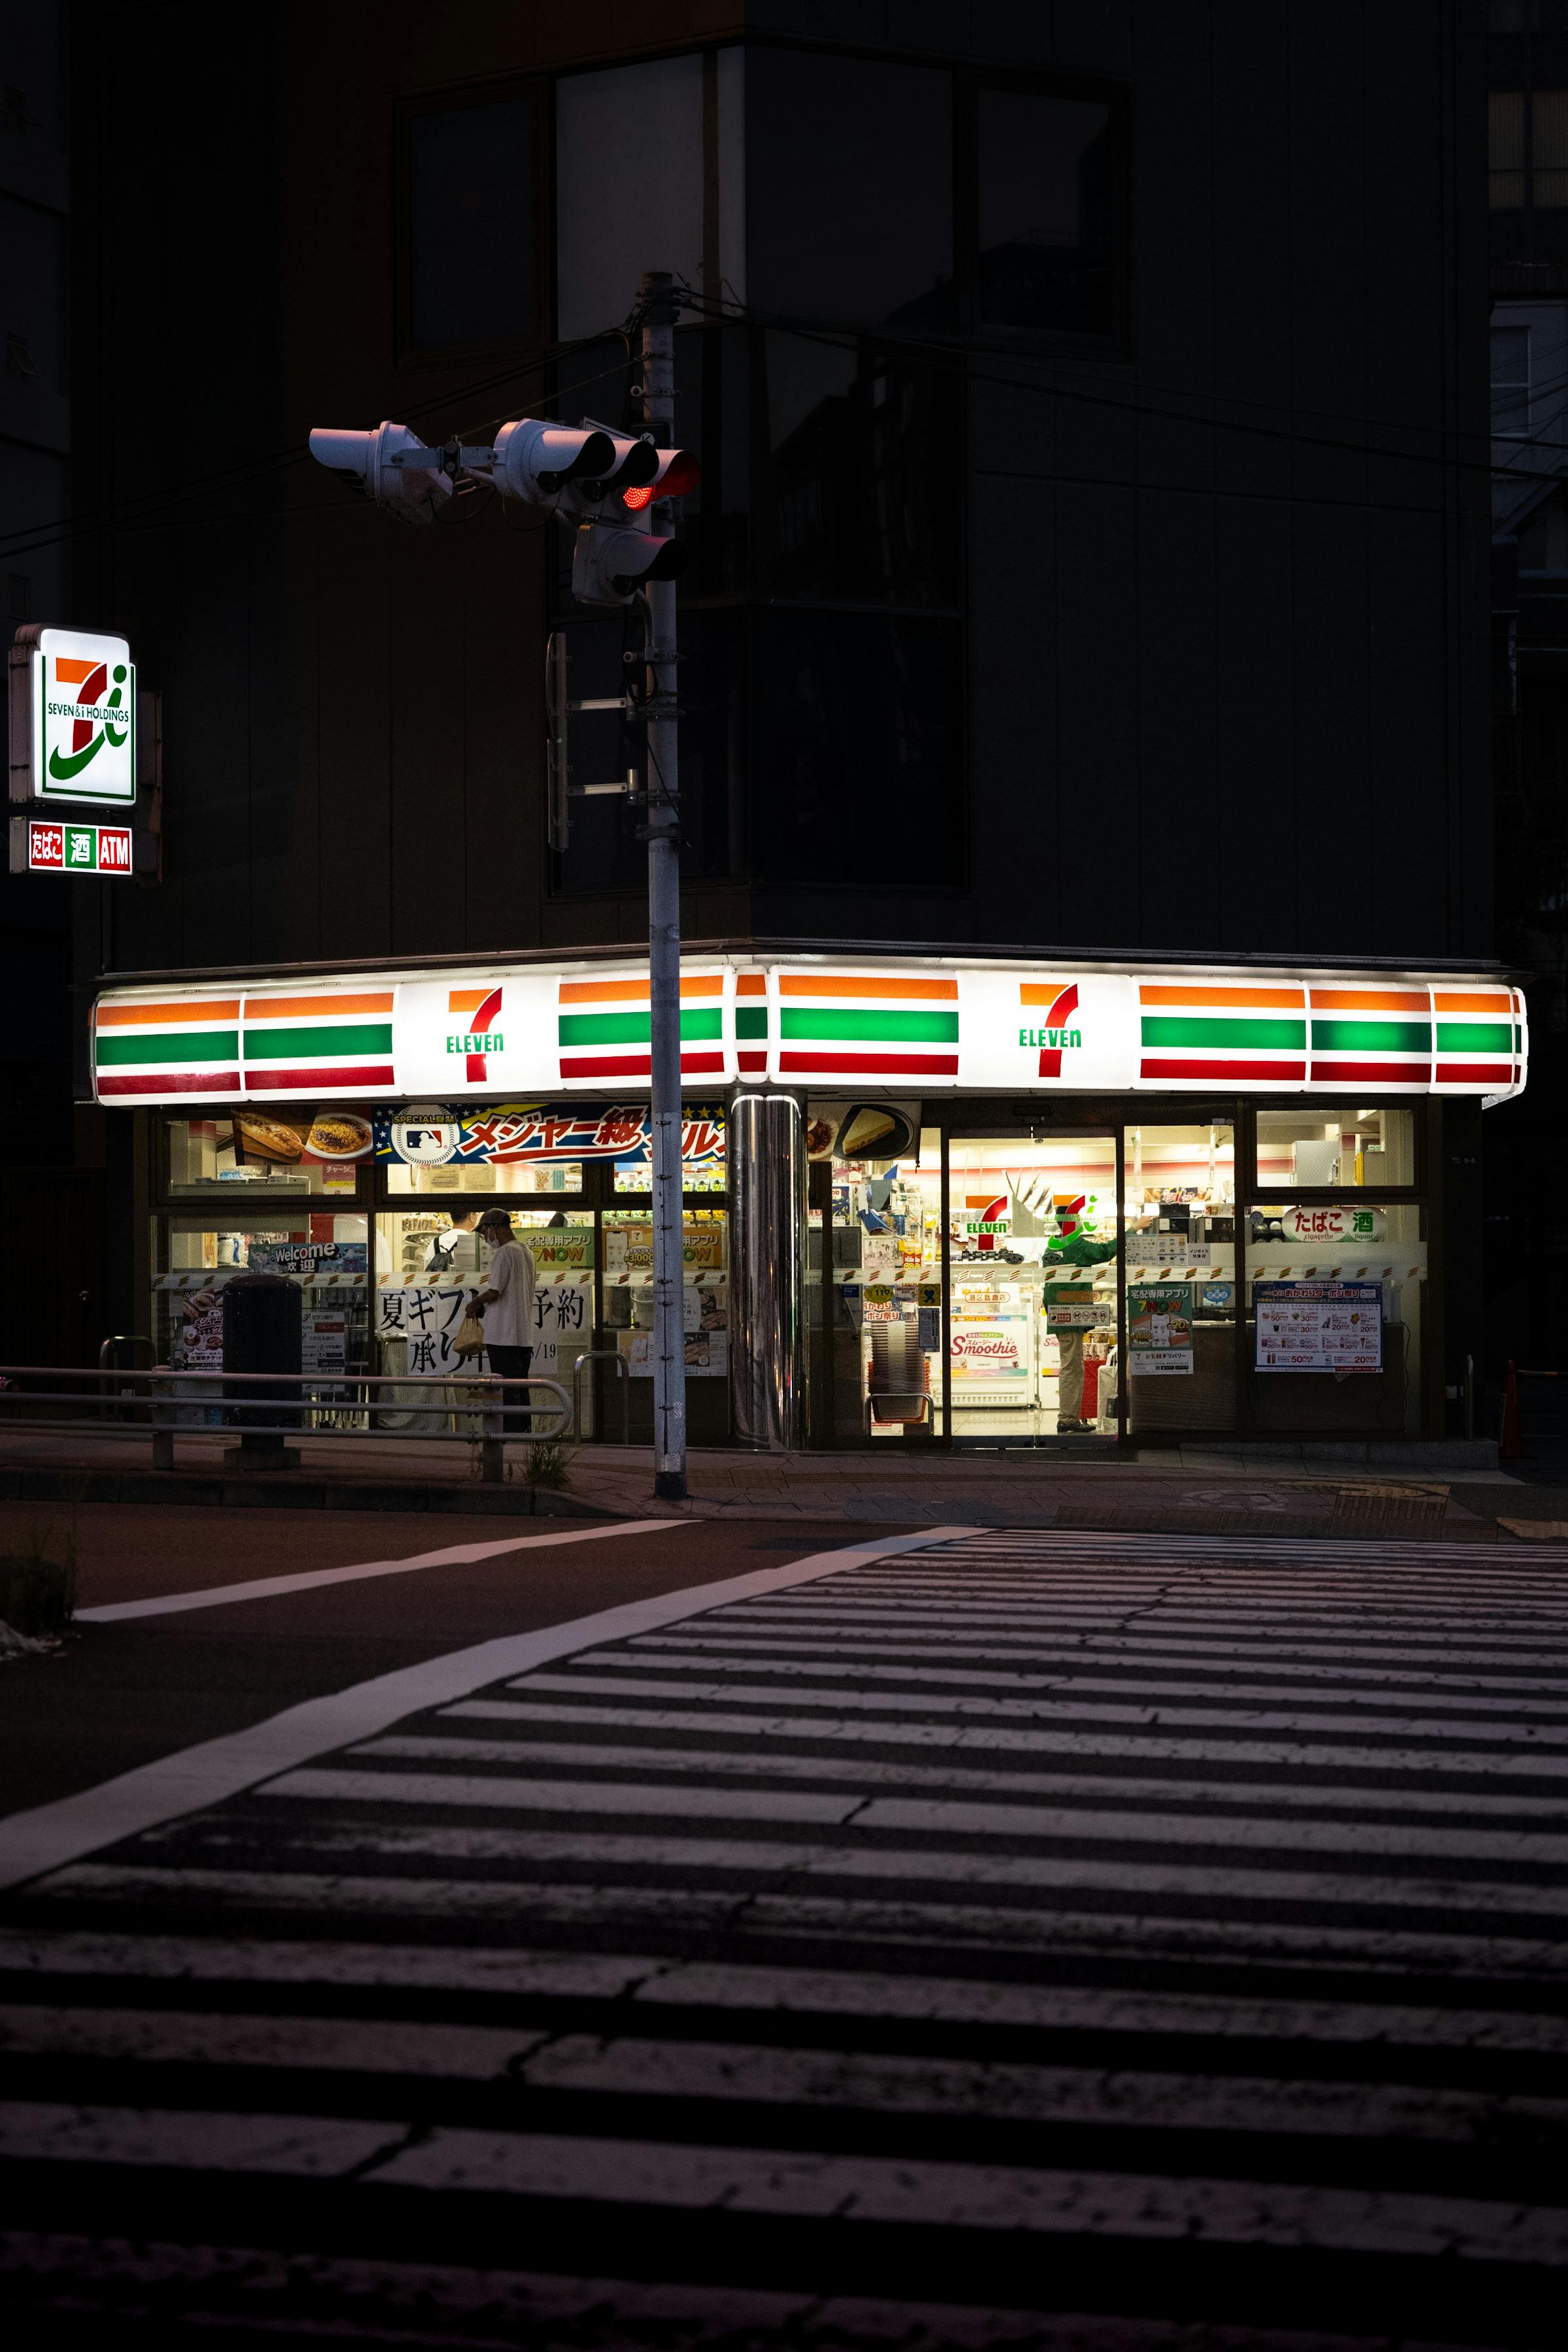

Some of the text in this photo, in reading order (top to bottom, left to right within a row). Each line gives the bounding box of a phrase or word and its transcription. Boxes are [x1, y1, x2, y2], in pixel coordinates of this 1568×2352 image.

[87, 708, 129, 722] HOLDINGS
[32, 830, 129, 865] たばこ 酒 ATM
[1296, 1211, 1373, 1232] たばこ 酒
[525, 1235, 591, 1247] 宅配専用アプリ
[276, 1243, 336, 1262] Welcome
[1131, 1289, 1189, 1299] 宅配専用アプリ
[951, 1335, 1018, 1356] Smoothie
